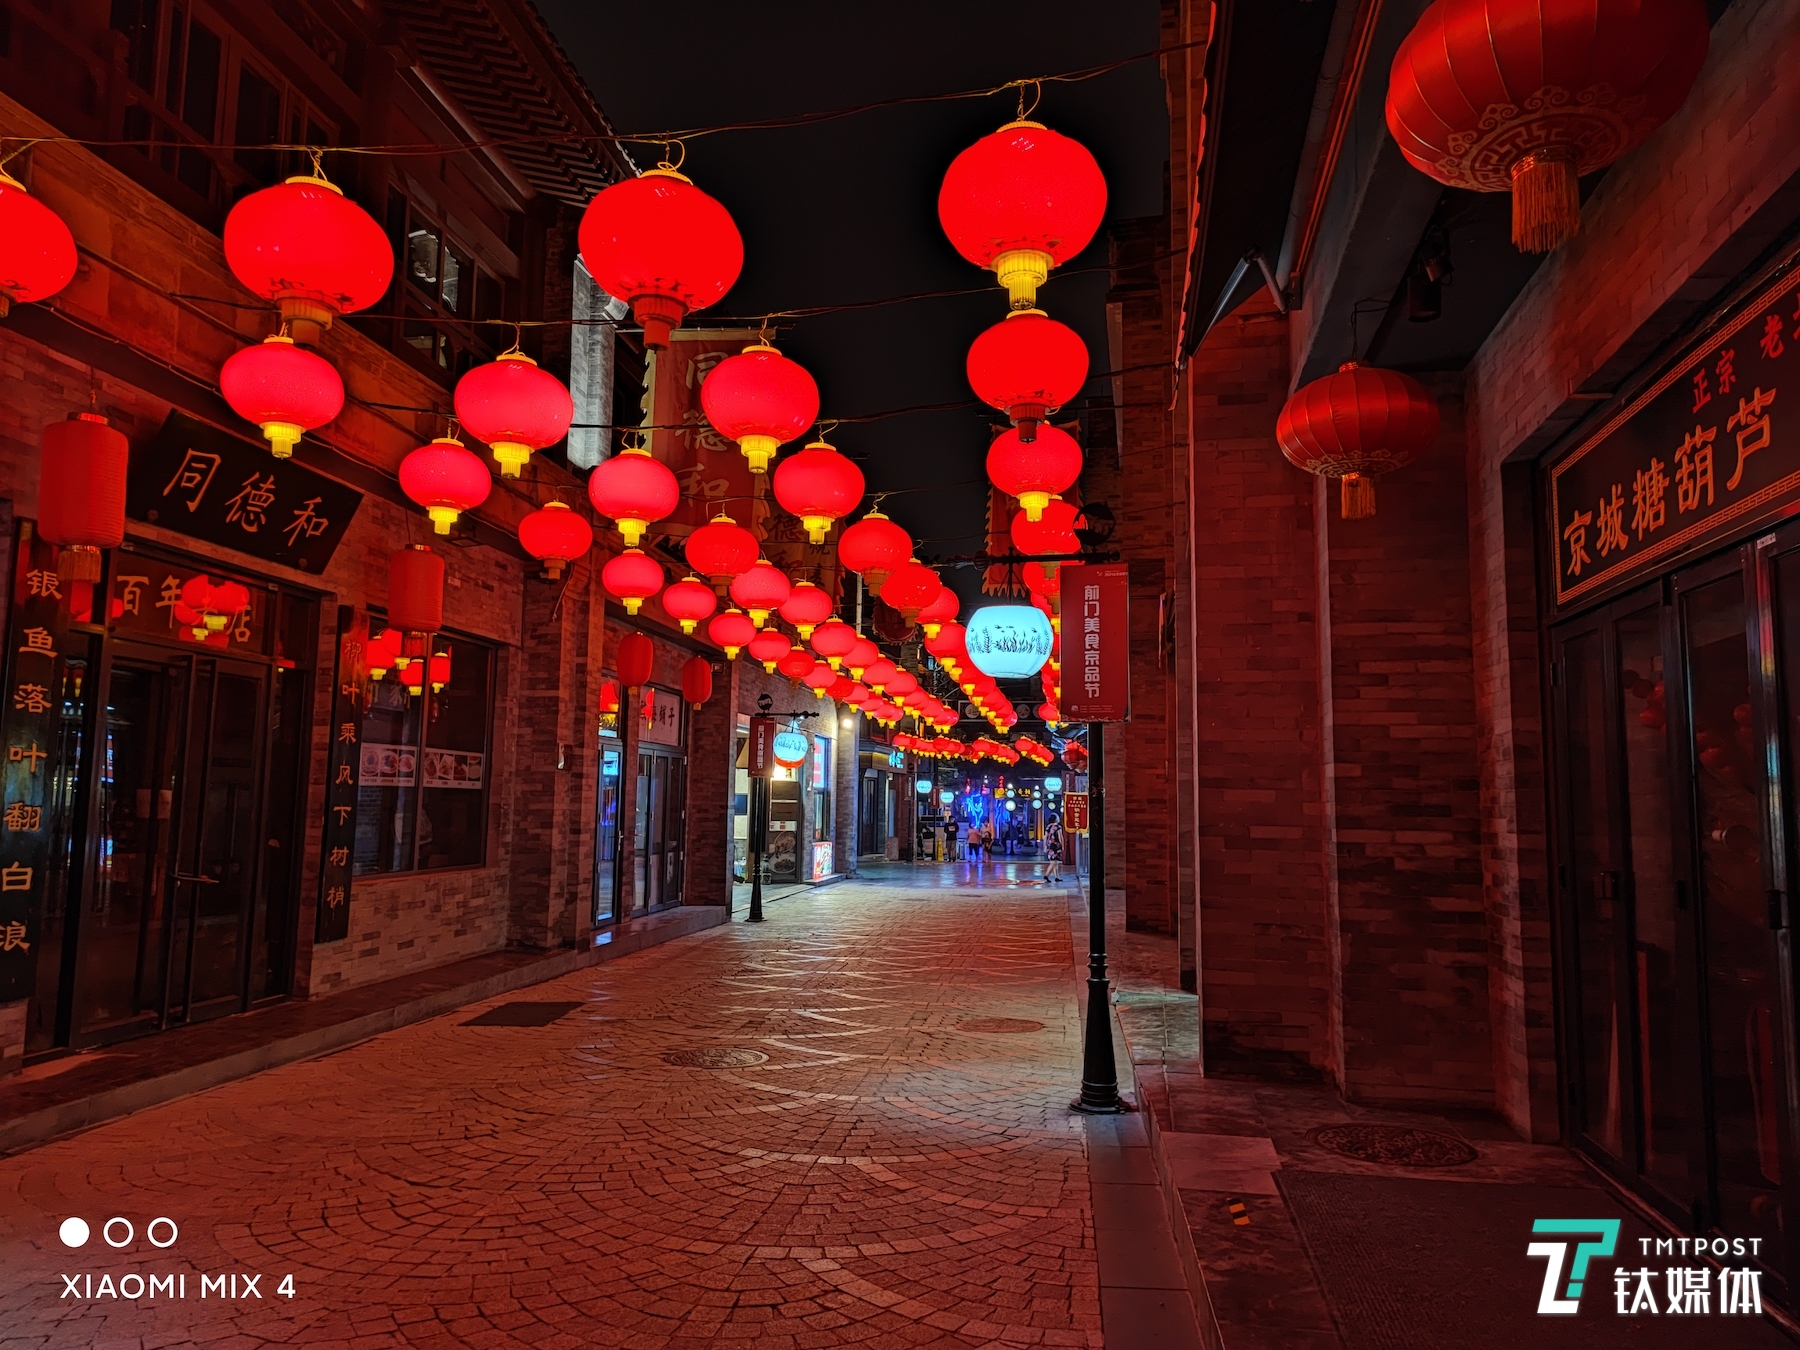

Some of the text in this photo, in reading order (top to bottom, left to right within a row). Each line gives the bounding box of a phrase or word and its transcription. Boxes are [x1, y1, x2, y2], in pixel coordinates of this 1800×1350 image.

[1691, 347, 1737, 415] 正宗
[162, 447, 330, 547] 同德和
[1563, 385, 1777, 577] 京城糖葫芦
[1083, 584, 1101, 699] 前门美食京品节
[326, 638, 363, 910] 柳叶乘风下树梢
